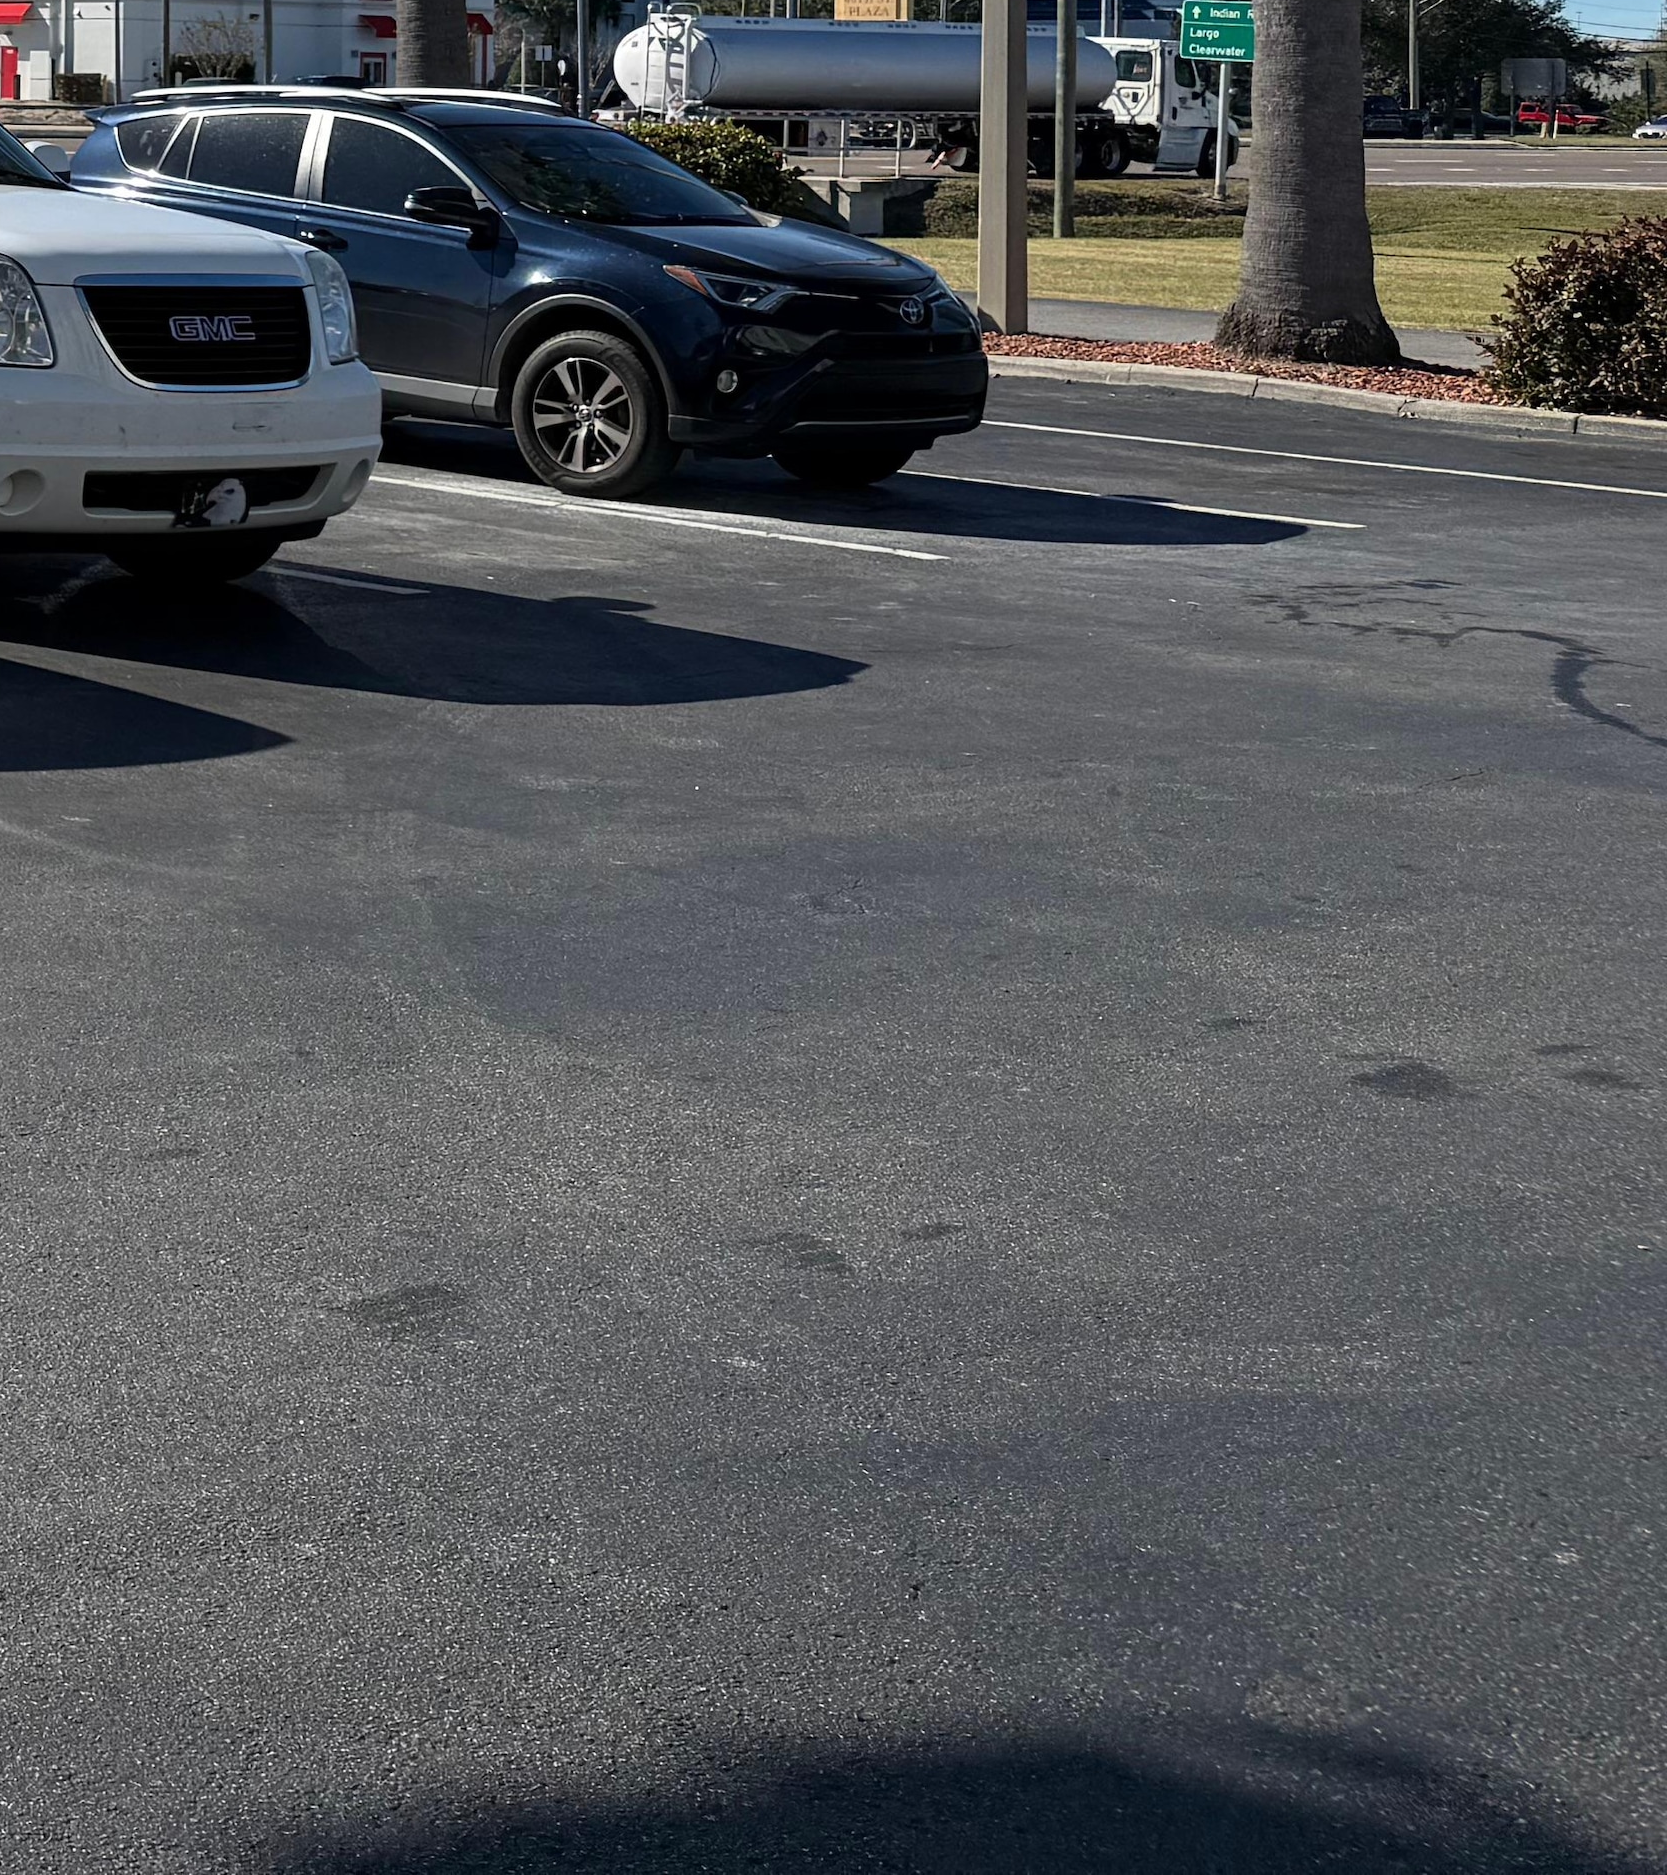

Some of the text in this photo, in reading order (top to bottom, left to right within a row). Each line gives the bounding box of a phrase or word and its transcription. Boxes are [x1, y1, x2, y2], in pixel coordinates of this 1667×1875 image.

[849, 6, 889, 17] PLAZA
[1209, 7, 1240, 19] Indian
[1189, 27, 1220, 41] Largo
[1189, 43, 1246, 57] Clearwater
[169, 316, 256, 341] GMC
